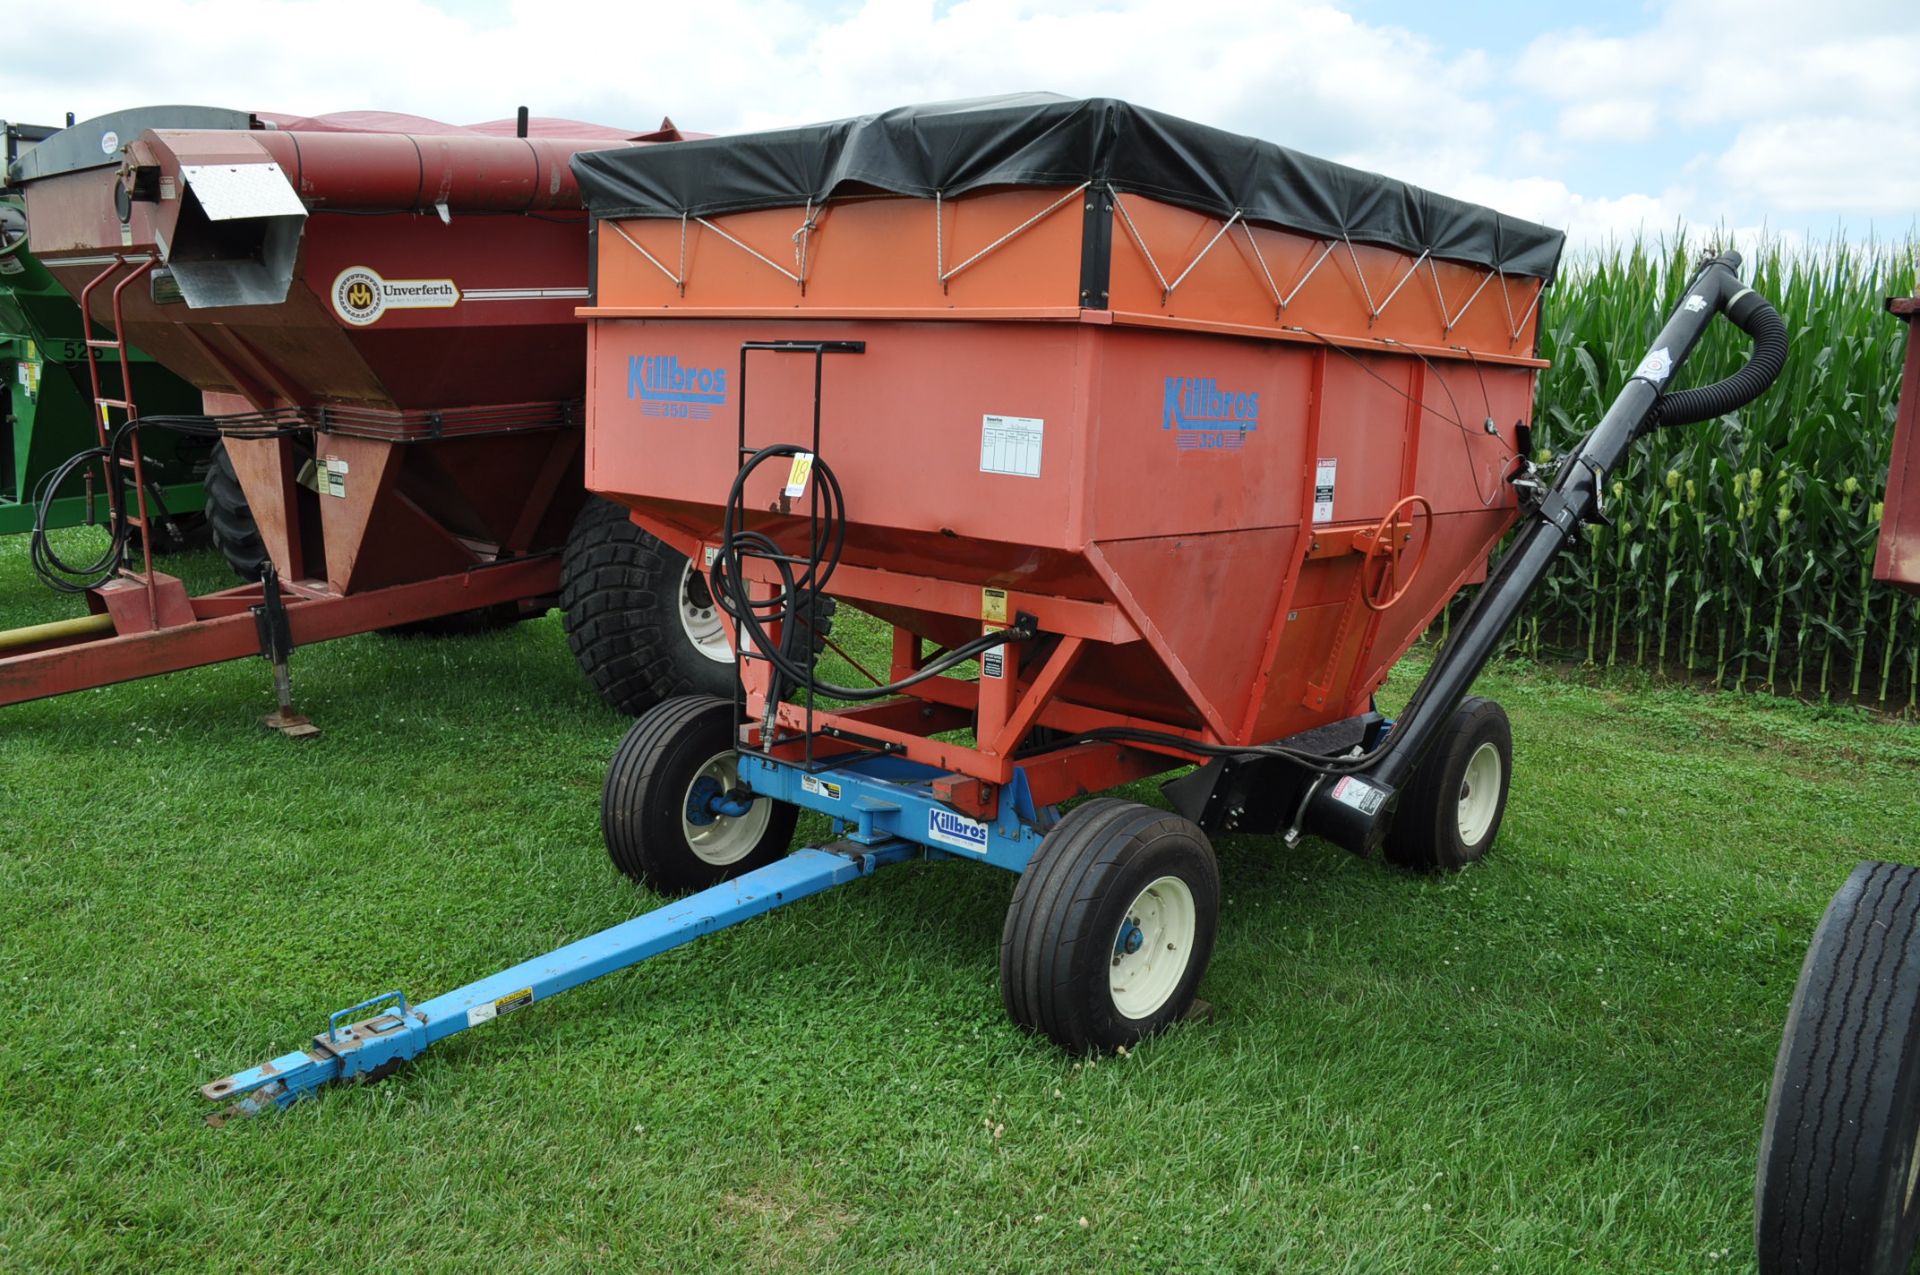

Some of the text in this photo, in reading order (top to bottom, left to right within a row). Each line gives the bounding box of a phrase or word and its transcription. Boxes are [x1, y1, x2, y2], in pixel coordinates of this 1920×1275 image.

[383, 284, 453, 296] Unverferth
[628, 355, 726, 401] Killbros
[663, 404, 688, 418] 350
[1163, 376, 1259, 430] Killbros
[1199, 433, 1223, 448] 350
[792, 460, 809, 485] 18
[931, 810, 986, 840] Killbros
